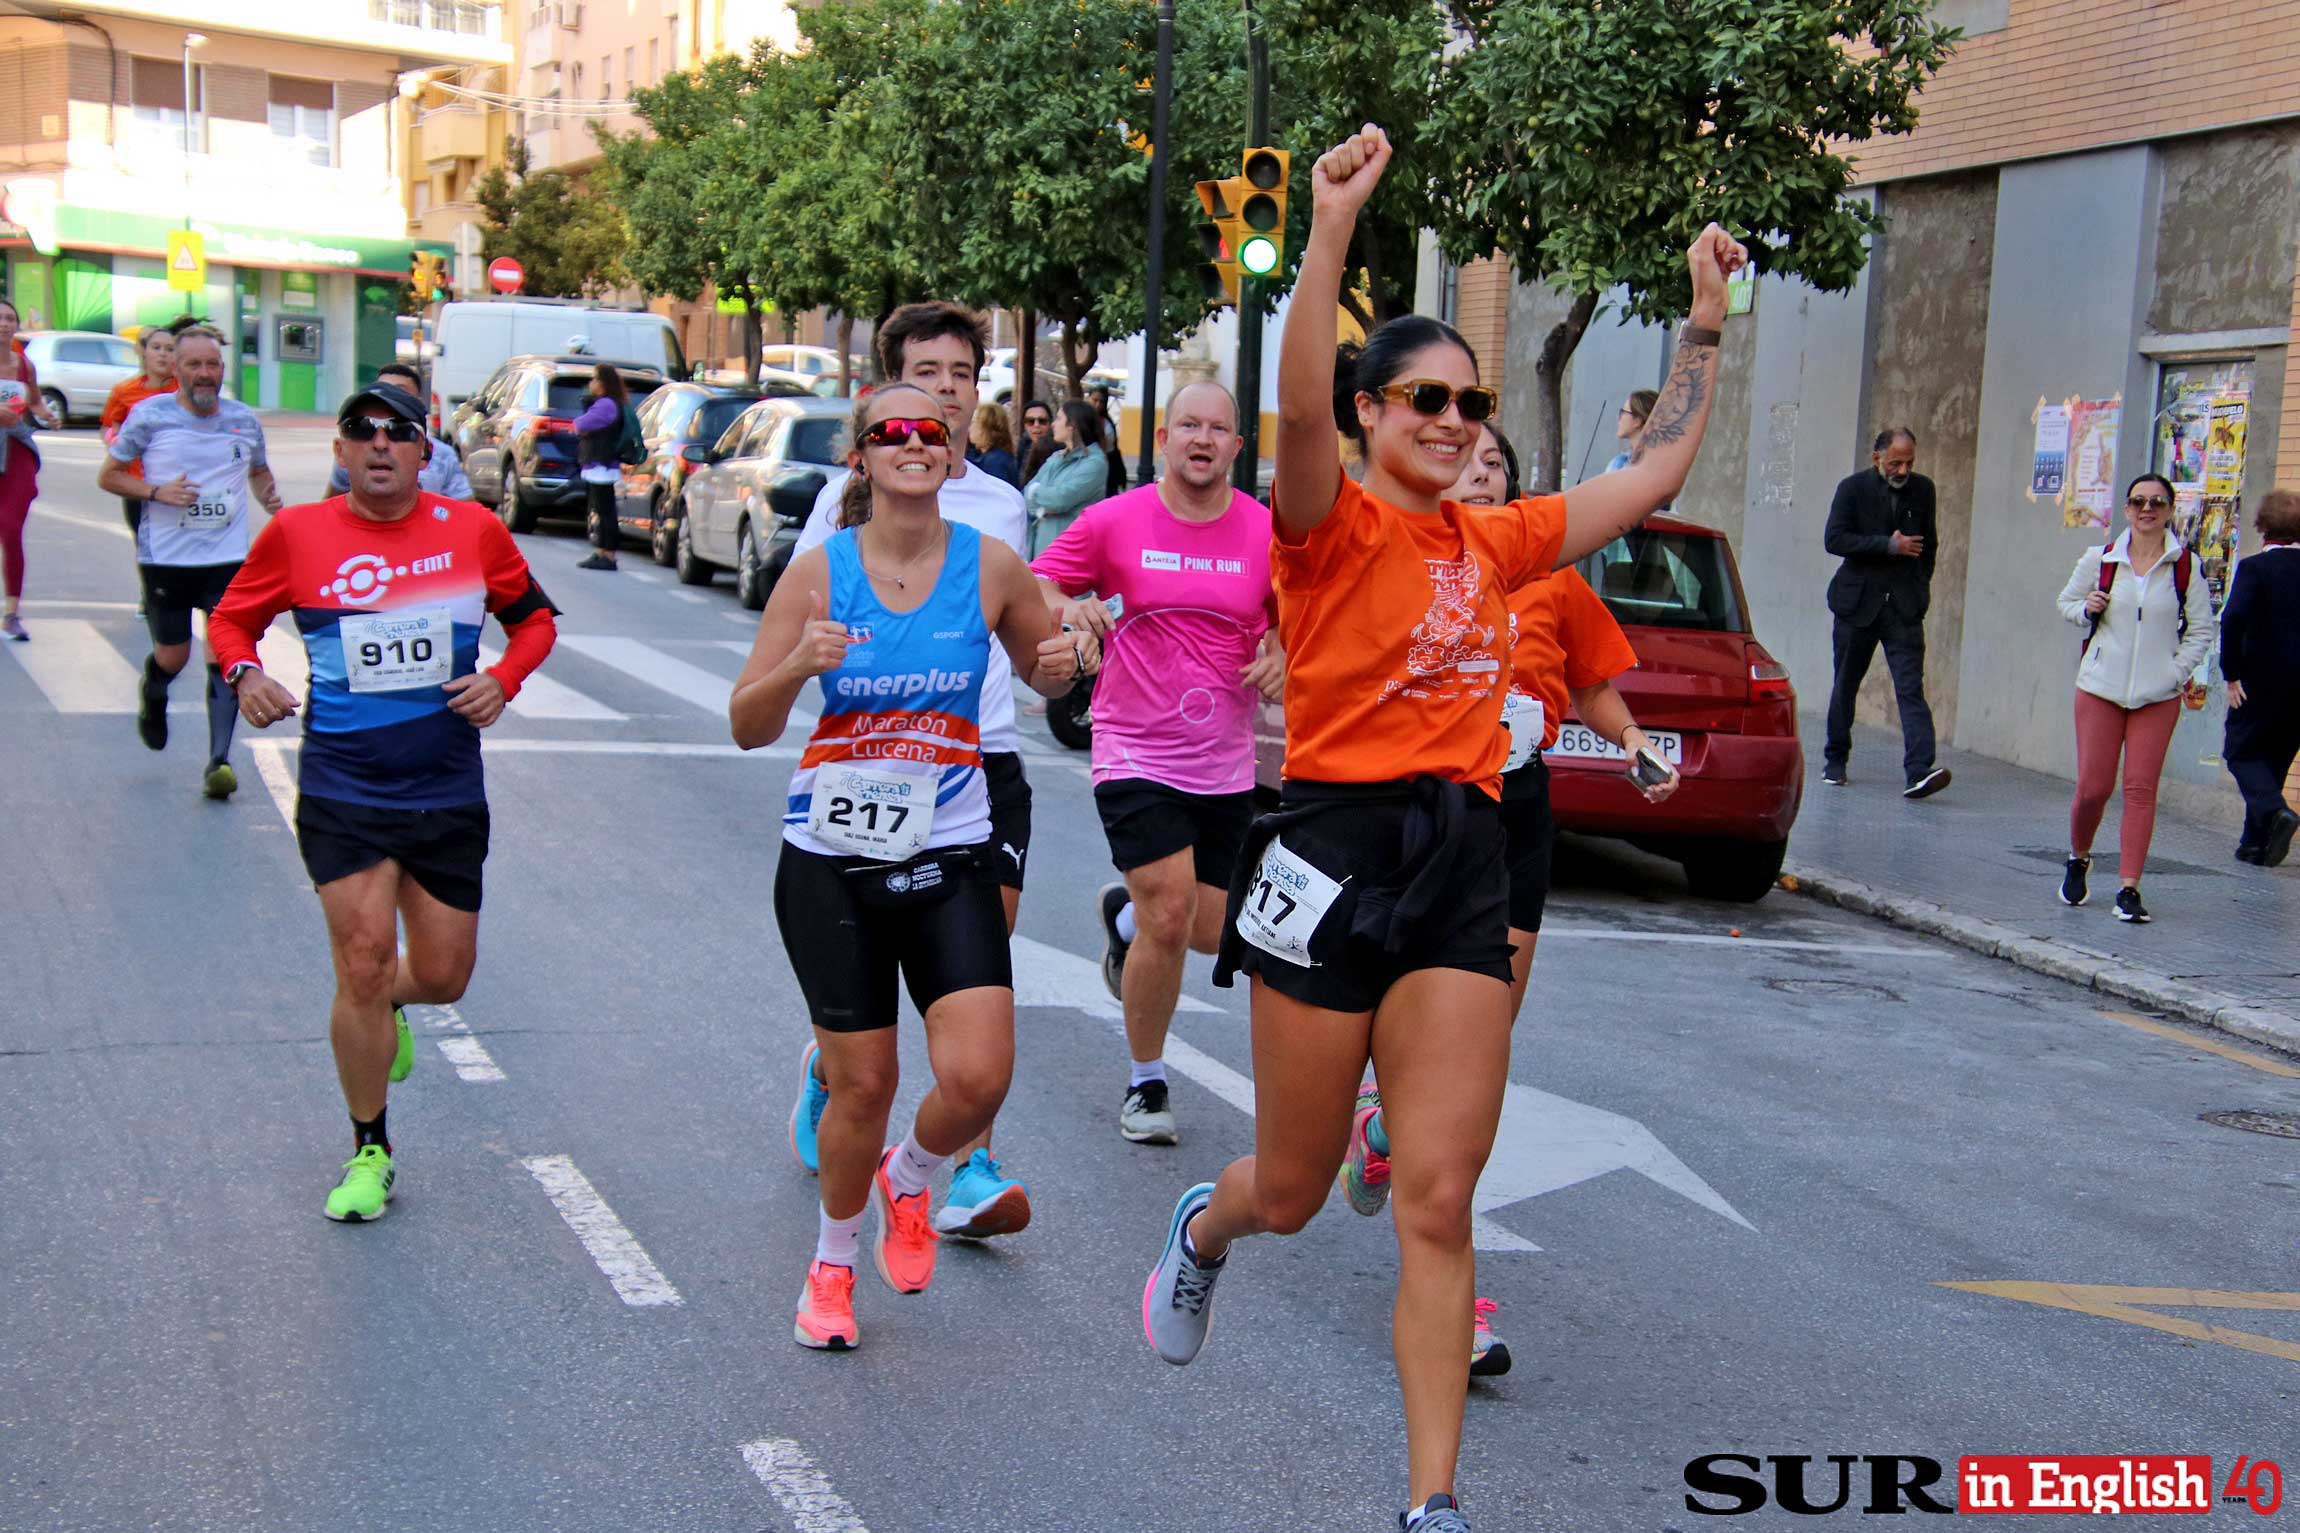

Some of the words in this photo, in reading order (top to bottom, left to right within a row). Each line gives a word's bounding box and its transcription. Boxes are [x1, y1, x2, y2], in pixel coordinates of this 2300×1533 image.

[188, 503, 226, 516] 350
[1184, 557, 1213, 572] PINK
[1216, 559, 1241, 574] RUN
[360, 637, 432, 667] 910
[837, 669, 971, 697] enerplus
[852, 711, 948, 735] Maratón
[852, 742, 937, 762] Lucena
[1562, 729, 1620, 754] 669
[827, 796, 910, 834] 217
[1250, 863, 1297, 926] 817
